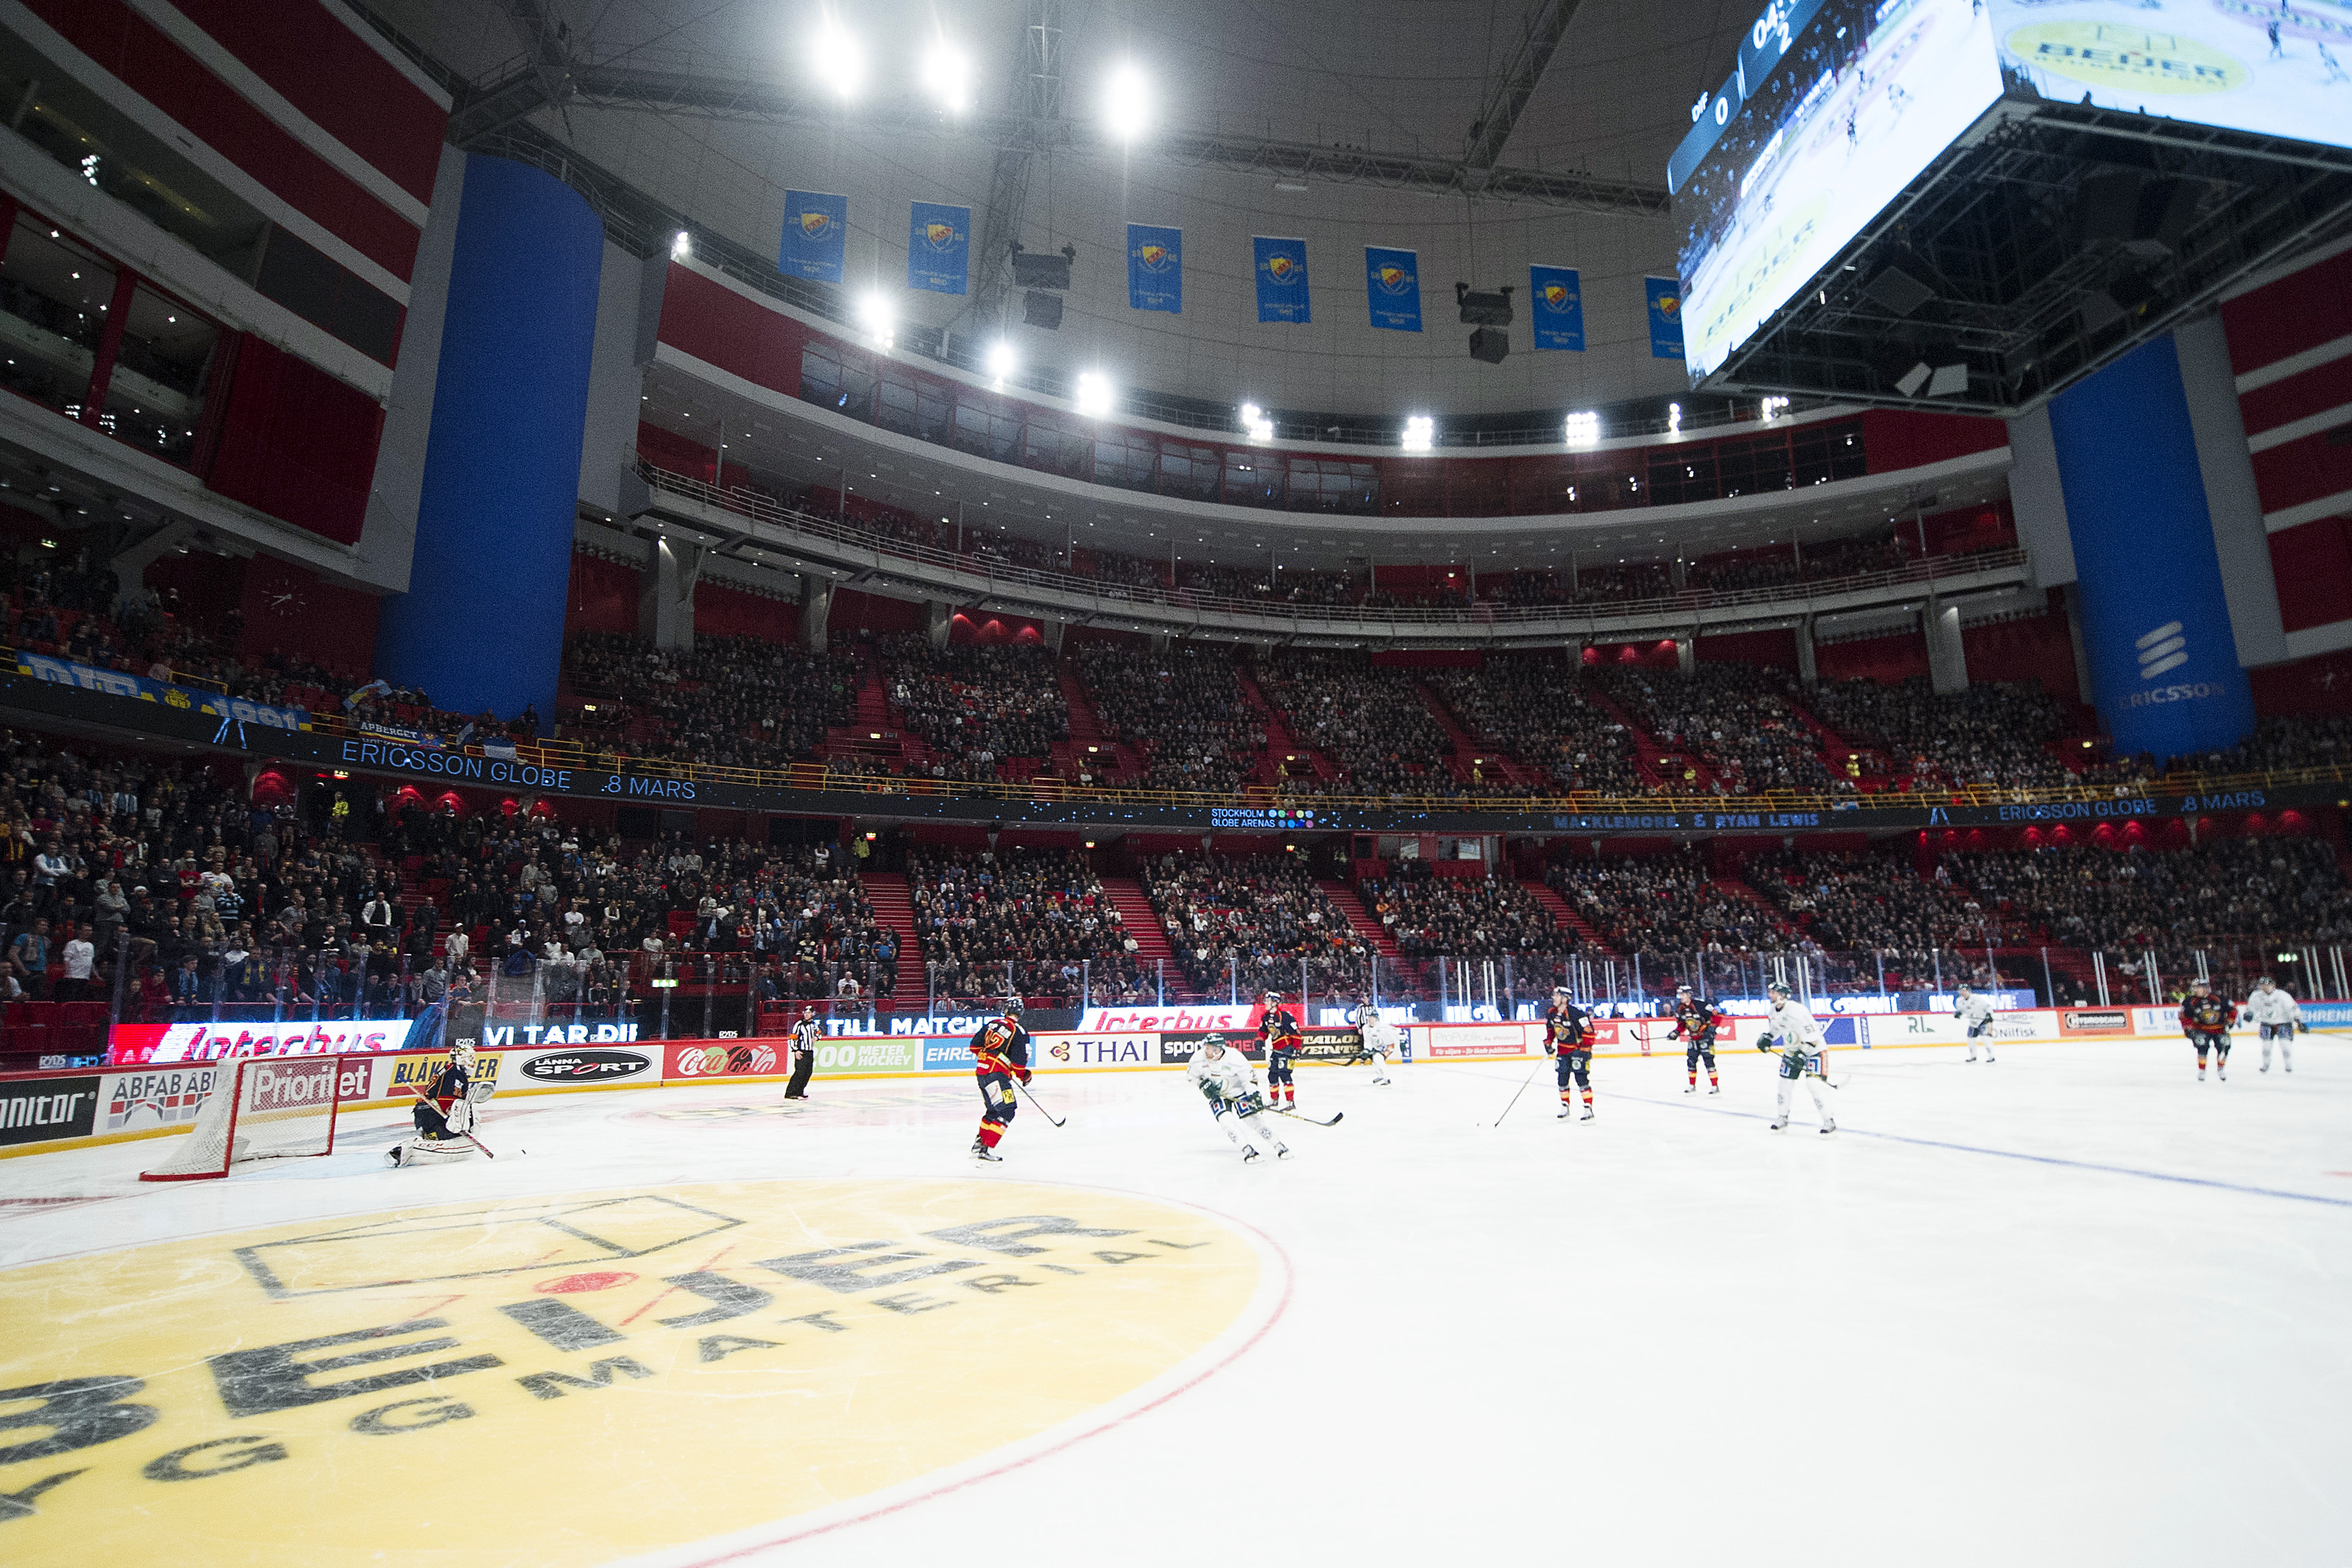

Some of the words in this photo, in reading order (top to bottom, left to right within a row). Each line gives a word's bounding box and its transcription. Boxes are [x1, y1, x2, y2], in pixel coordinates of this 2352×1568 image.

[1777, 22, 1793, 55] 2
[1715, 97, 1729, 125] 0
[342, 740, 482, 779] ERICSSON
[491, 761, 572, 790] GLOBE
[607, 775, 621, 793] 8
[629, 777, 695, 800] MARS
[1211, 808, 1264, 819] STOCKHOLM
[1998, 802, 2090, 822] ERICSSON
[2093, 798, 2159, 817] GLOBE
[2202, 790, 2265, 809] MARS
[1211, 818, 1240, 827] GLOBE
[1241, 818, 1276, 828] ARENAS
[1552, 815, 1676, 830] MACKLEMORE
[1693, 814, 1708, 828] &
[1715, 814, 1761, 828] RYAN
[1769, 813, 1820, 827] LEWIS
[826, 1018, 884, 1037] TILL
[1095, 1010, 1232, 1031] Interbus
[484, 1026, 514, 1046] VI
[523, 1023, 588, 1045] TAR
[1999, 1027, 2037, 1037] Nilfisk
[181, 1025, 386, 1061] Interbus
[858, 1044, 905, 1056] METER
[1076, 1041, 1148, 1063] THAI
[1164, 1041, 1203, 1057] spor
[394, 1056, 498, 1084] BLÅKER
[534, 1061, 645, 1076] SPORT
[535, 1058, 583, 1066] LÄNNA
[858, 1054, 912, 1067] HOCKEY
[112, 1073, 181, 1101] ÅBFAB
[254, 1065, 368, 1106] Prioritet
[0, 1214, 1144, 1467] BEIJER
